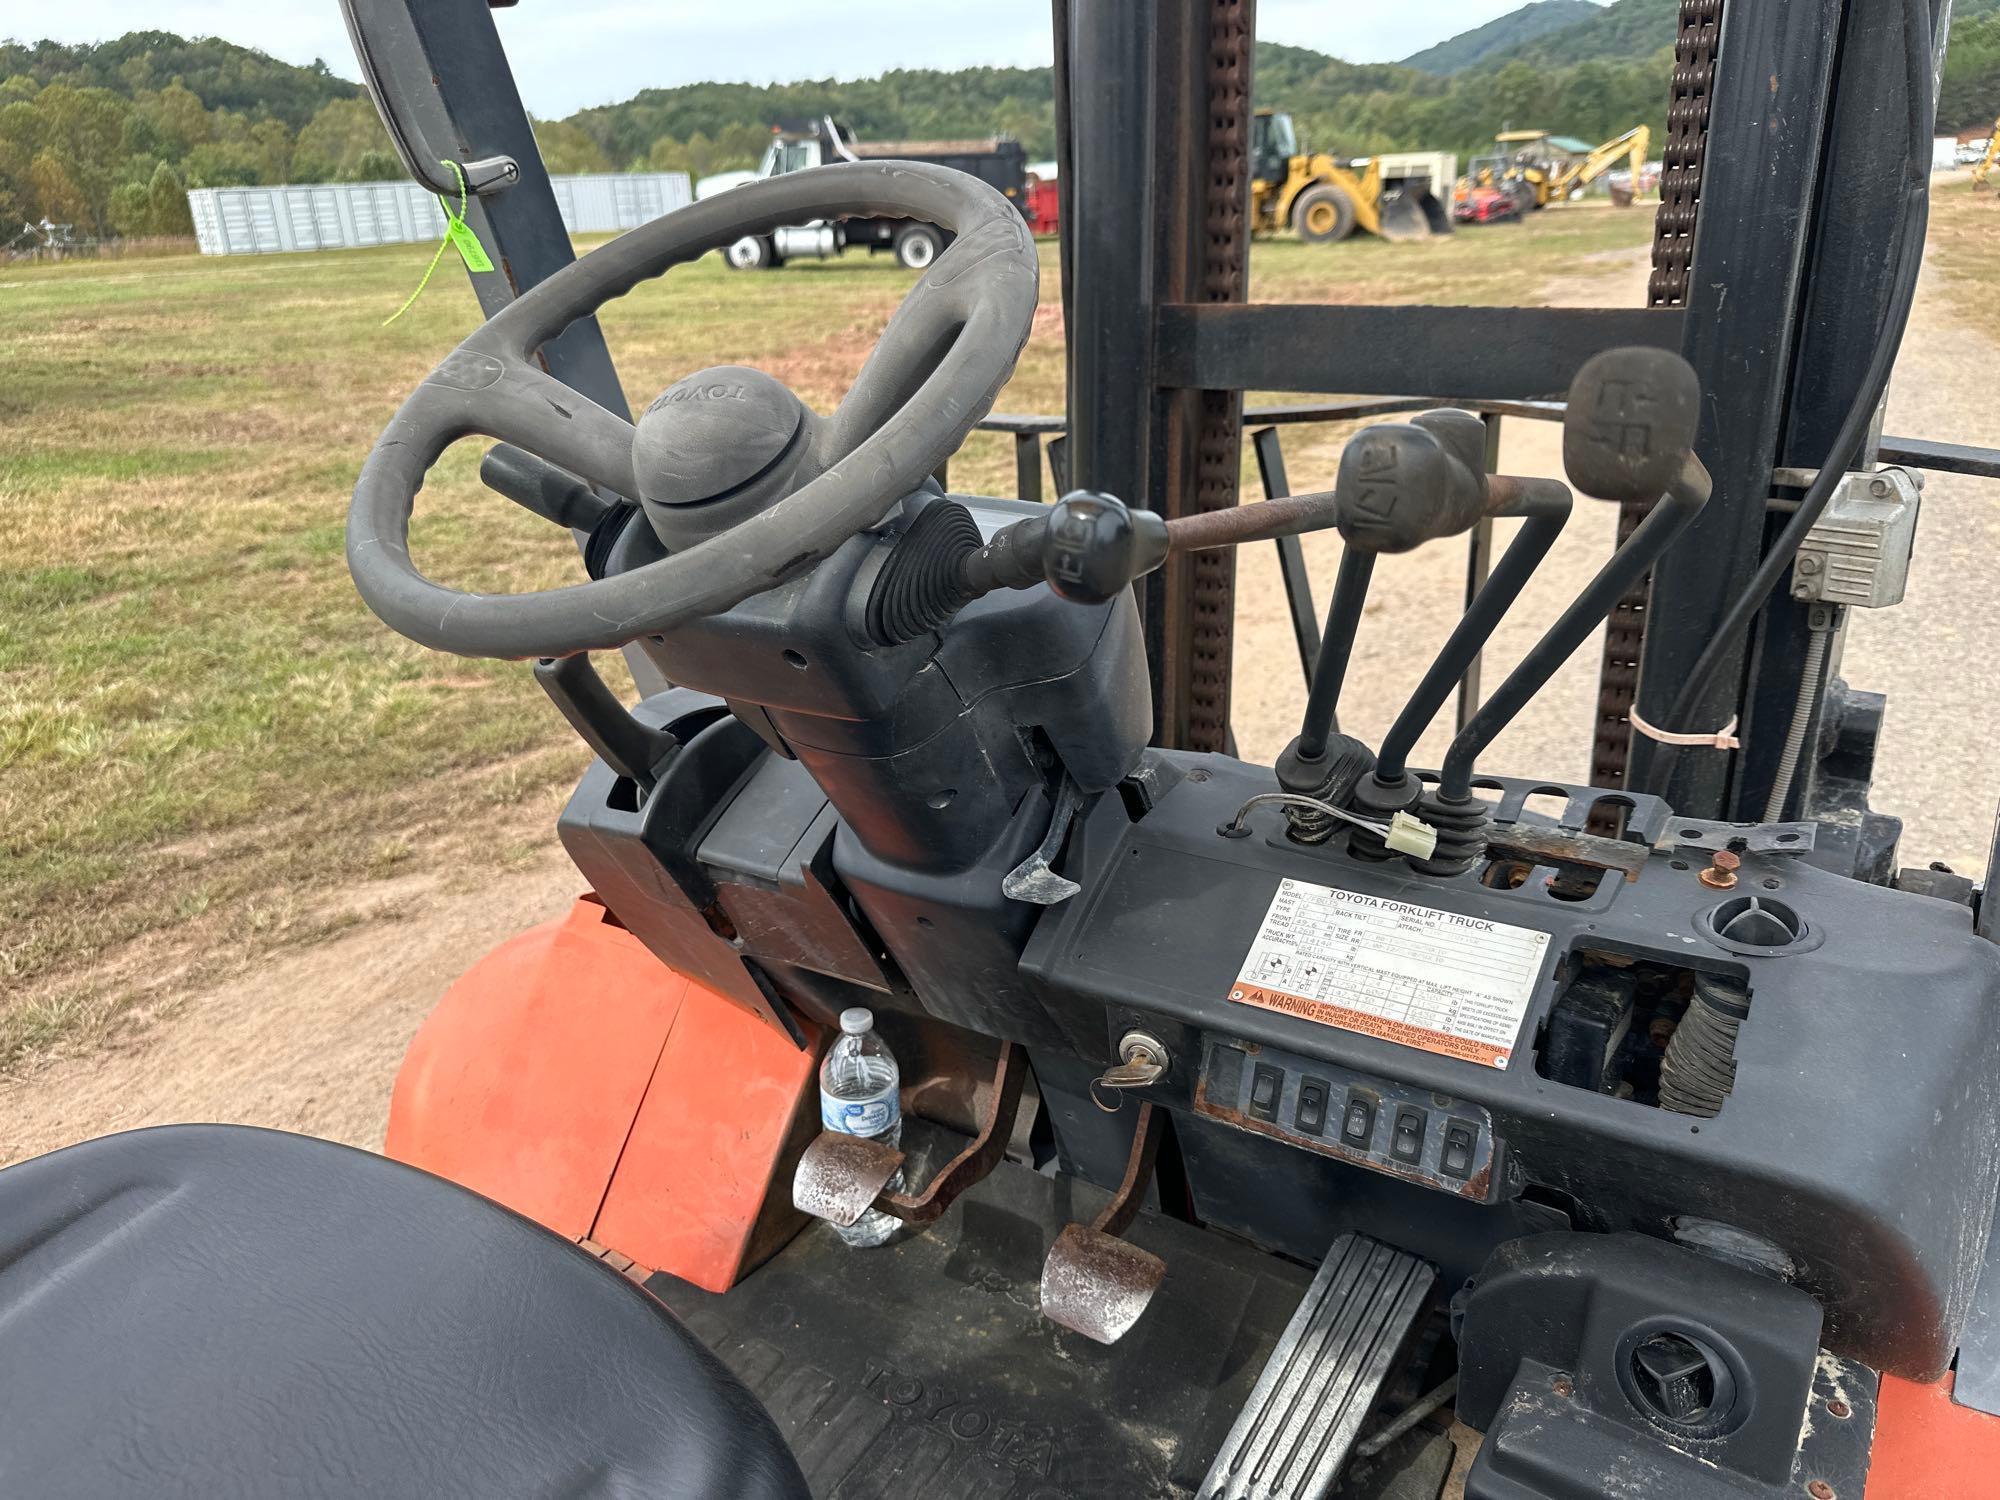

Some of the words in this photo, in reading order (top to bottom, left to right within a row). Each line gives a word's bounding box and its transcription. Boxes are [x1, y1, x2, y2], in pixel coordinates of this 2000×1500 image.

[1282, 890, 1302, 899] MODEL
[1278, 897, 1296, 905] MAST
[1275, 904, 1290, 913] TYPE
[1329, 889, 1377, 908] TOYOTA
[1381, 902, 1445, 921] FORKLIFT
[1448, 915, 1495, 932] TRUCK
[1271, 913, 1293, 922] FRONT
[1335, 909, 1353, 918] BACK
[1354, 913, 1368, 921] TILT
[1400, 915, 1424, 926] SERIAL
[1269, 919, 1290, 928] TREAD
[1398, 923, 1422, 933] ATTACH
[1265, 928, 1284, 938] TRUCK
[1335, 933, 1349, 941] SIZE
[1337, 927, 1352, 935] TIRE
[1353, 929, 1363, 937] FR
[1296, 950, 1312, 959] RATED
[1312, 953, 1337, 963] CAPACITY
[1350, 961, 1375, 973] VERTICAL
[1376, 968, 1391, 976] MAST
[1391, 972, 1418, 982] EQUIPPED
[1452, 987, 1473, 996] HEIGHT
[1492, 996, 1514, 1005] SHOWN
[1426, 986, 1454, 998] CAPACITY
[1268, 993, 1317, 1017] WARNING
[1459, 1013, 1492, 1026] SPECIFICATIONS
[1482, 1010, 1501, 1019] EXCEEDS
[1501, 1015, 1518, 1023] DESIGN
[1314, 1014, 1333, 1024] READ
[1333, 1020, 1375, 1035] OPERATOR'S
[1376, 1030, 1405, 1044] MANUAL
[1320, 1002, 1353, 1016] IMPROPER
[1353, 1011, 1392, 1027] OPERATION
[1393, 1020, 1403, 1029] OR
[1404, 1025, 1454, 1042] MAINTENANCE
[1454, 1036, 1480, 1048] COULD
[1480, 1043, 1509, 1055] RESULT
[1324, 1010, 1347, 1022] INJURY
[1349, 1015, 1359, 1023] OR
[1359, 1018, 1383, 1031] DEATH.
[1387, 1026, 1417, 1039] TRAINED
[1417, 1034, 1459, 1050] OPERATORS
[1460, 1046, 1480, 1055] ONLY.
[1483, 1025, 1499, 1033] EFFECT
[1350, 1125, 1360, 1133] ON
[861, 1358, 1055, 1476] TOYOTA
